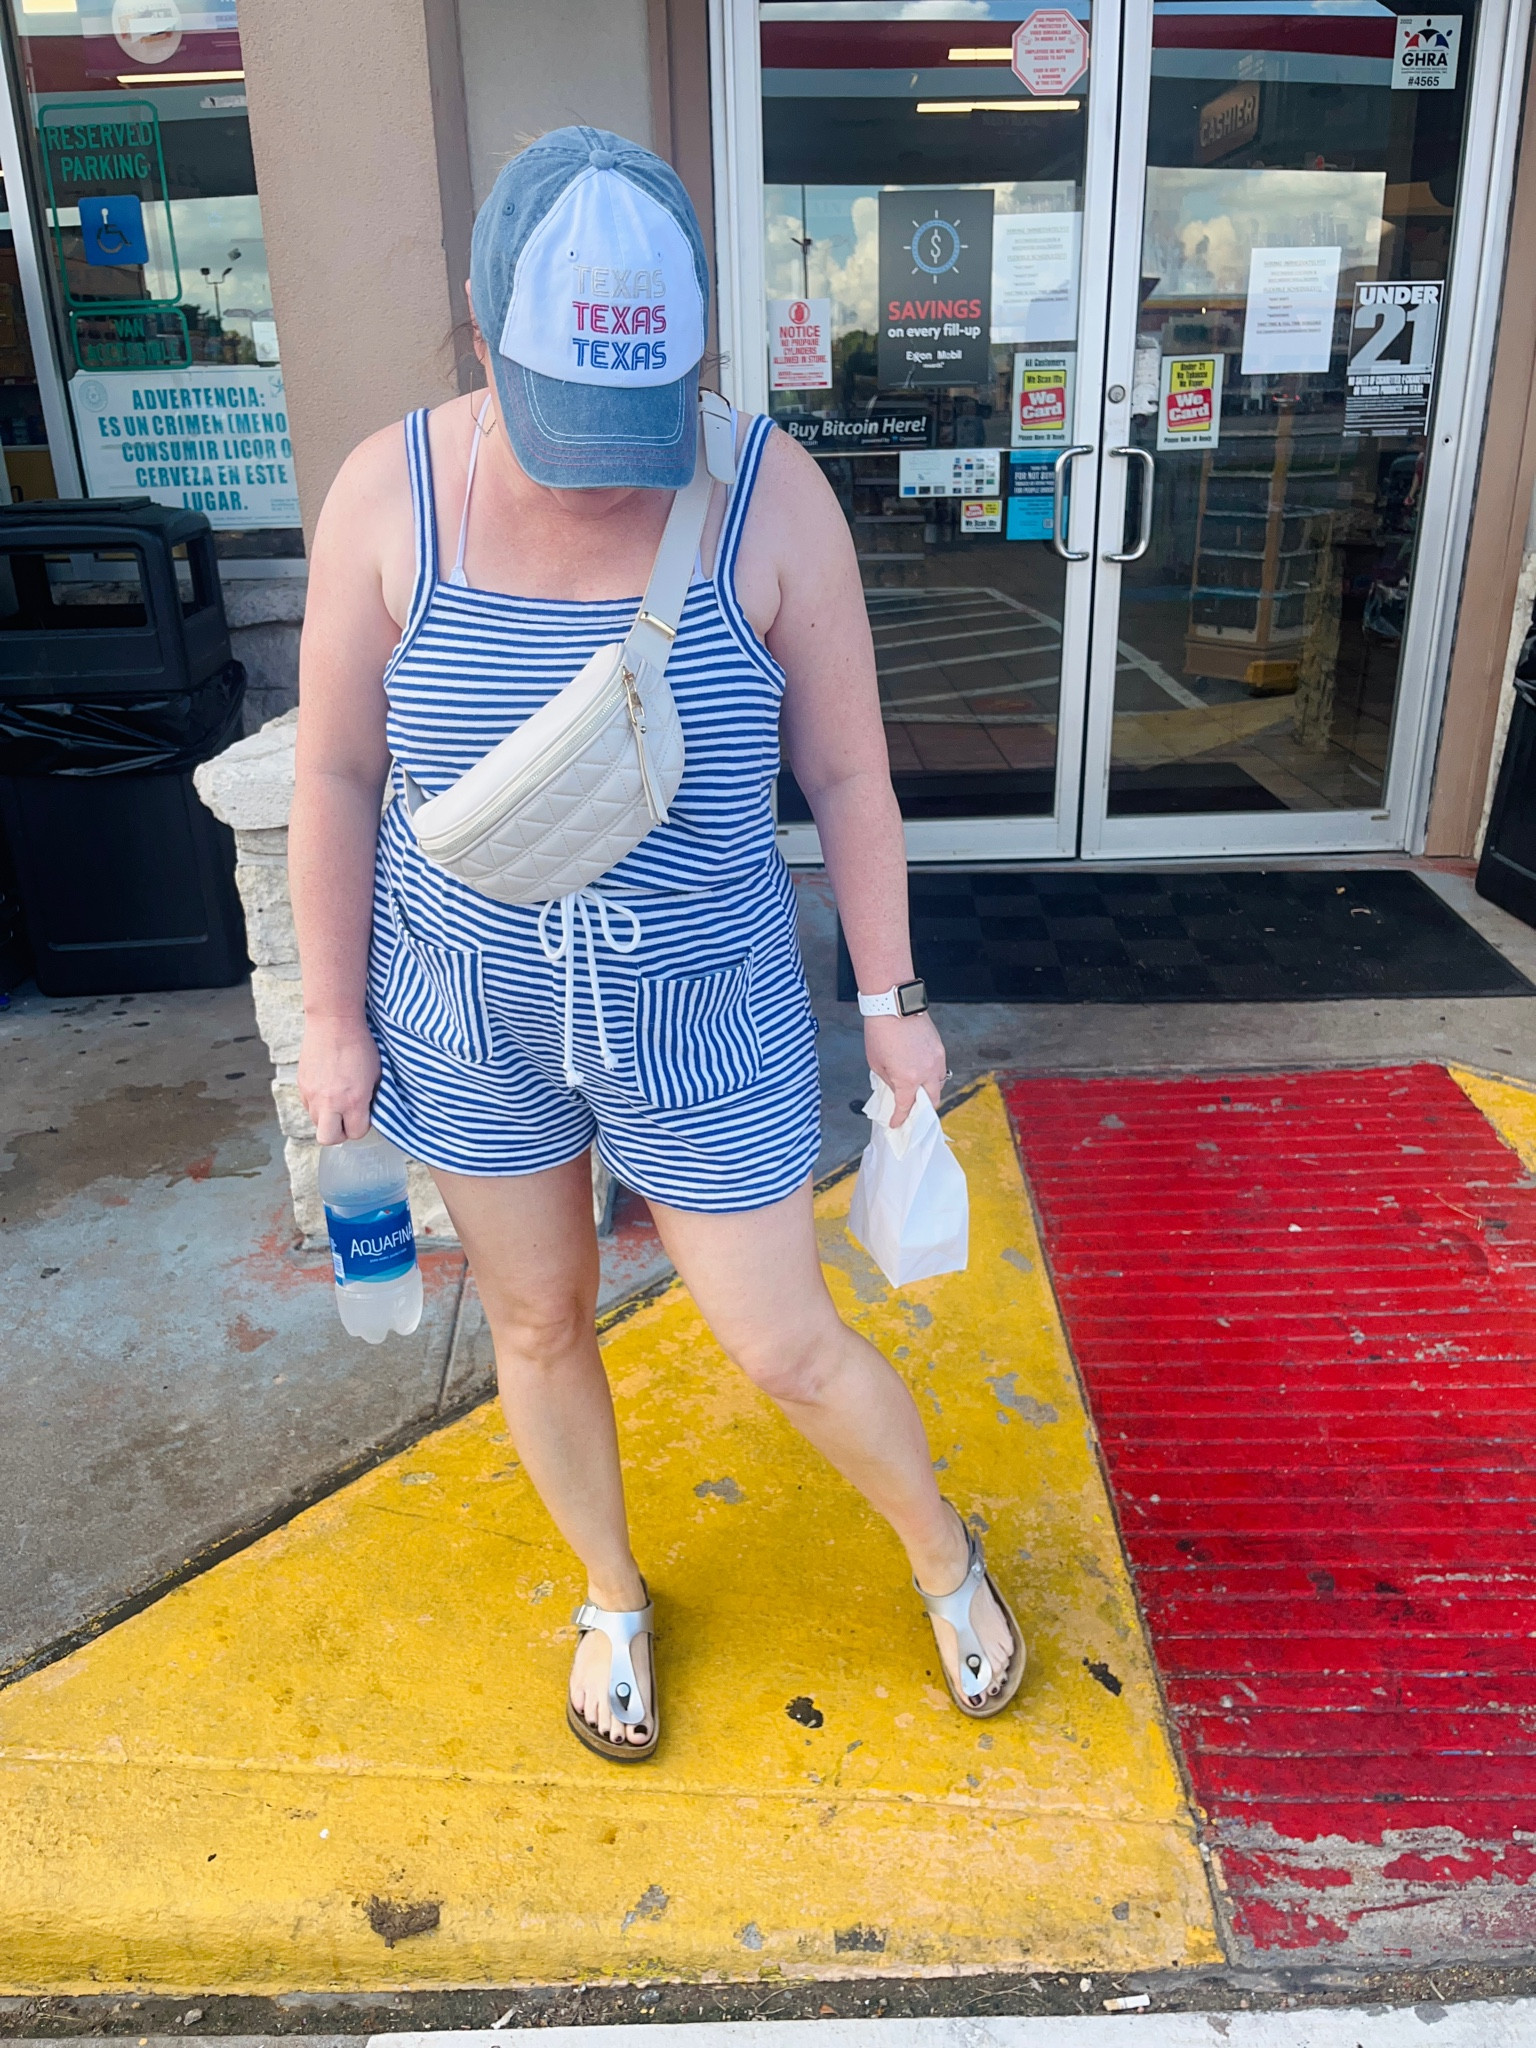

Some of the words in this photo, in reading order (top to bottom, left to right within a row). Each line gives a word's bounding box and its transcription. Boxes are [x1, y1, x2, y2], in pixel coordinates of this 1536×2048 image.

[1402, 52, 1448, 67] GHRA
[1408, 76, 1440, 86] #4565
[47, 121, 153, 150] RESERVED
[61, 153, 150, 182] PARKING
[573, 265, 666, 300] TEXAS
[1359, 286, 1439, 305] UNDER
[572, 301, 666, 335] TEXAS
[888, 299, 982, 321] SAVINGS
[114, 319, 145, 337] VAN
[780, 326, 820, 338] NOTICE
[888, 328, 904, 338] on
[906, 327, 941, 340] every
[943, 323, 981, 339] fill-up
[1350, 304, 1438, 367] 21
[792, 338, 819, 346] PROPANE
[572, 338, 667, 370] TEXAS
[906, 350, 933, 363] Exxon
[937, 350, 962, 360] Mobil
[132, 387, 265, 410] ADVERTENCIA:
[1028, 392, 1056, 405] We
[1175, 393, 1203, 407] We
[1022, 402, 1062, 419] Card
[1169, 403, 1209, 421] Card
[98, 416, 121, 437] ES
[124, 415, 149, 436] UN
[152, 414, 224, 436] CRIMEN
[788, 422, 819, 440] Buy
[822, 419, 879, 436] Bitcoin
[882, 416, 927, 433] Here!
[121, 440, 218, 462] CONSUMIR
[223, 439, 277, 459] LICOR
[280, 438, 292, 458] O
[135, 465, 214, 488] CERVEZA
[219, 465, 240, 486] EN
[246, 464, 288, 484] ESTE
[182, 491, 249, 511] LUGAR.
[351, 1222, 413, 1258] AQUAFINA
